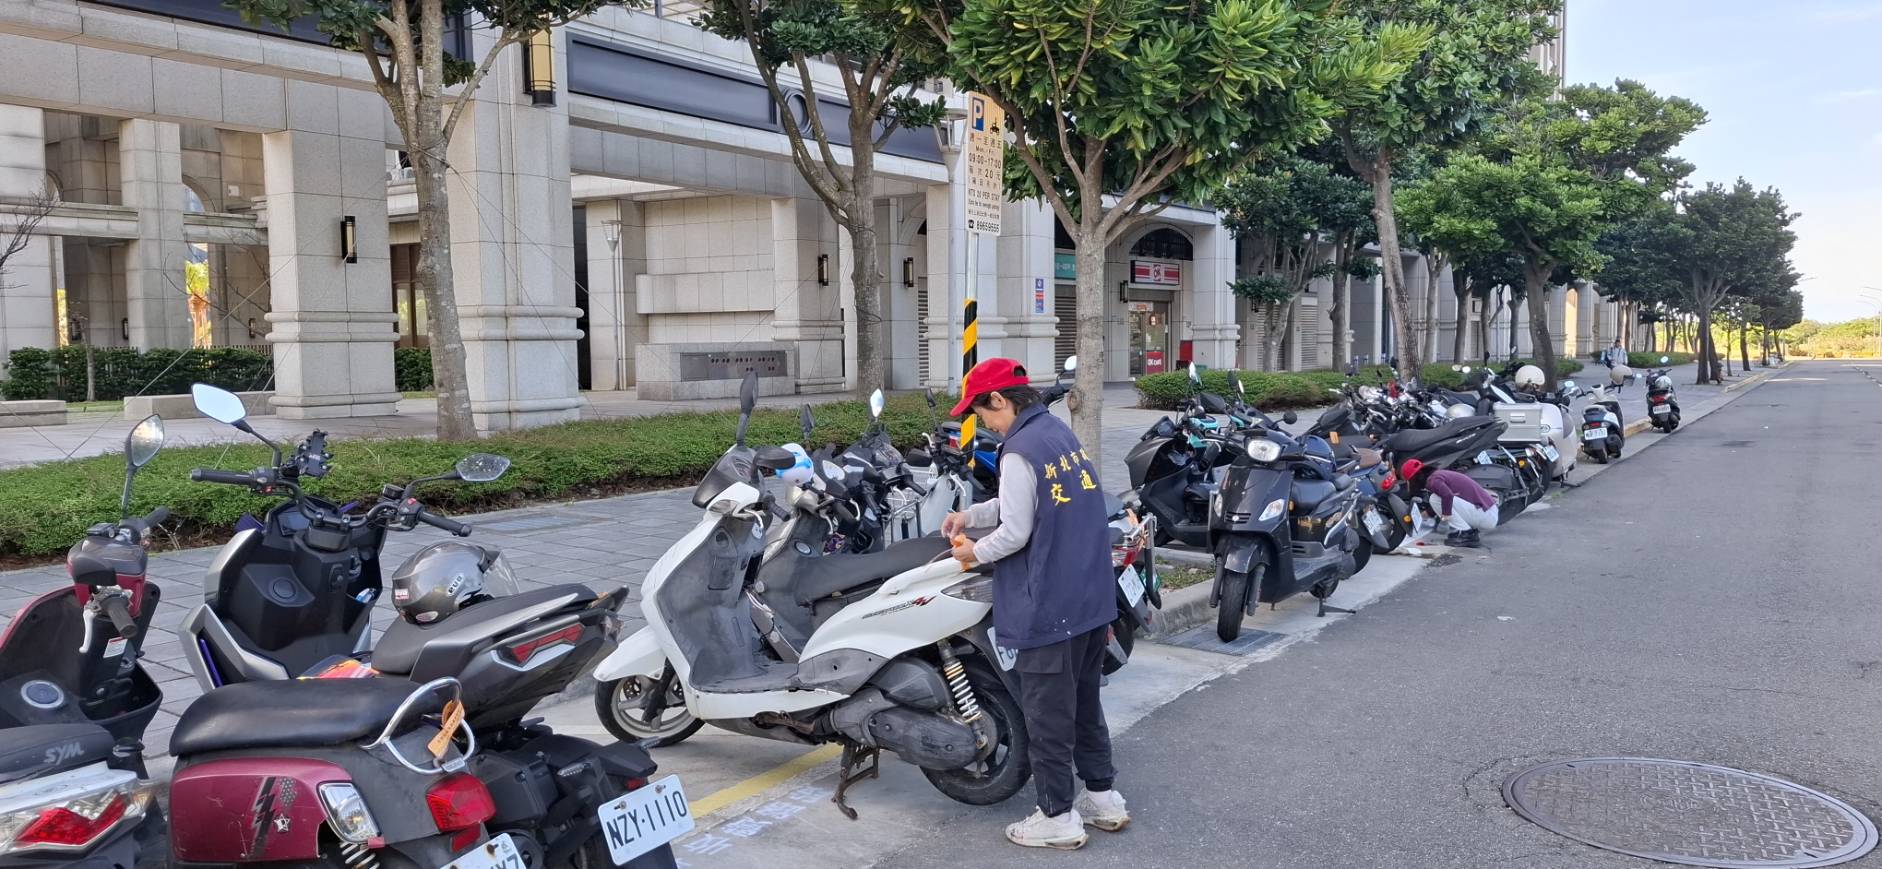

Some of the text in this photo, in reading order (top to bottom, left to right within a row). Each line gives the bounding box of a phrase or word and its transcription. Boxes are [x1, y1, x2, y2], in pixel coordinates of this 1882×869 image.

[973, 99, 984, 129] P
[968, 152, 1001, 169] 09:00-17:00
[44, 742, 84, 765] SYM
